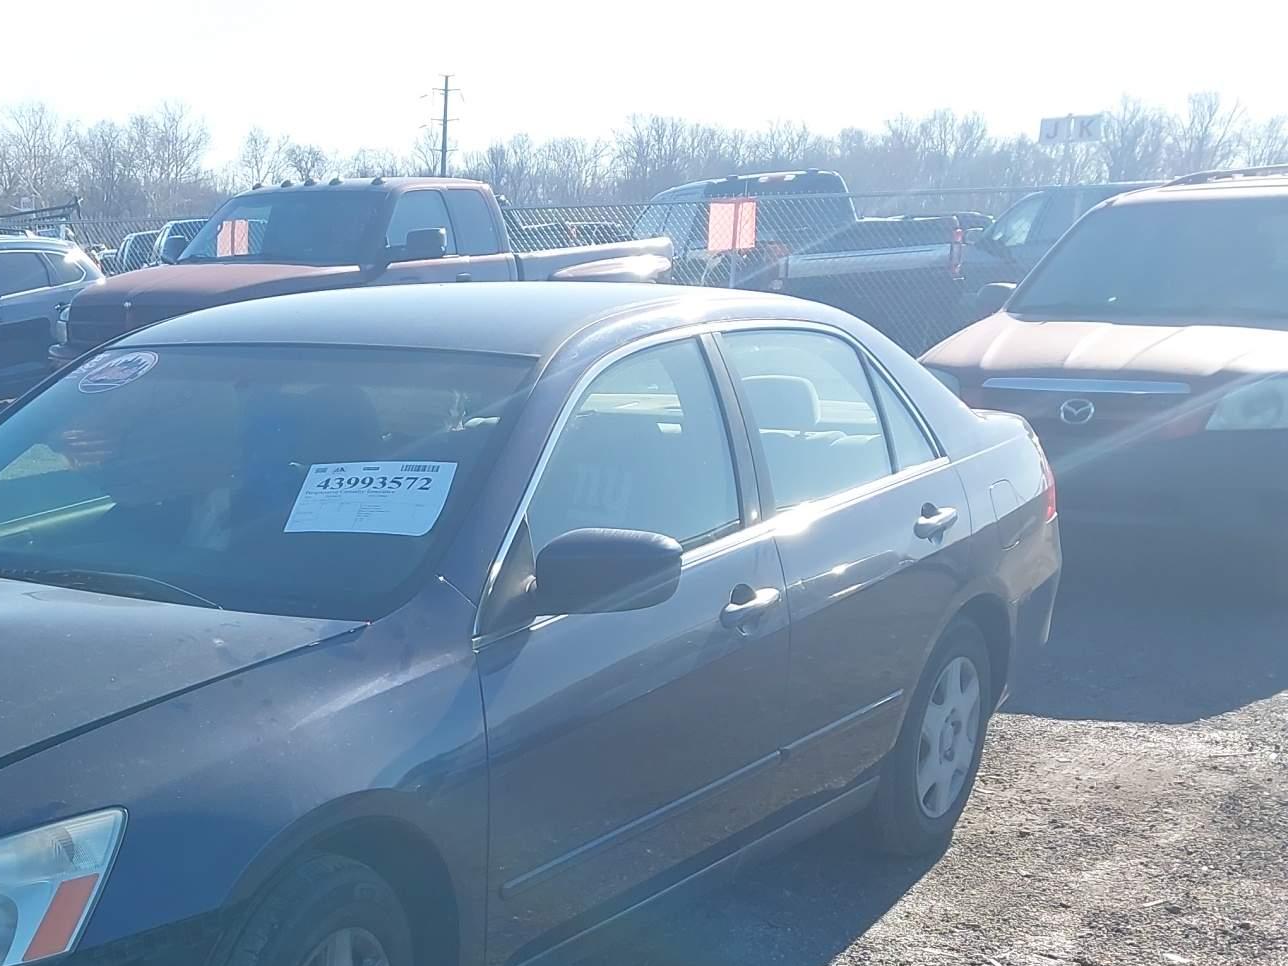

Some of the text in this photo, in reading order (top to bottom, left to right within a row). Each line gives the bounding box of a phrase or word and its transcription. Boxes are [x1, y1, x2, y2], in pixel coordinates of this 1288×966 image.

[1046, 118, 1094, 140] J K
[316, 476, 433, 491] 43993572
